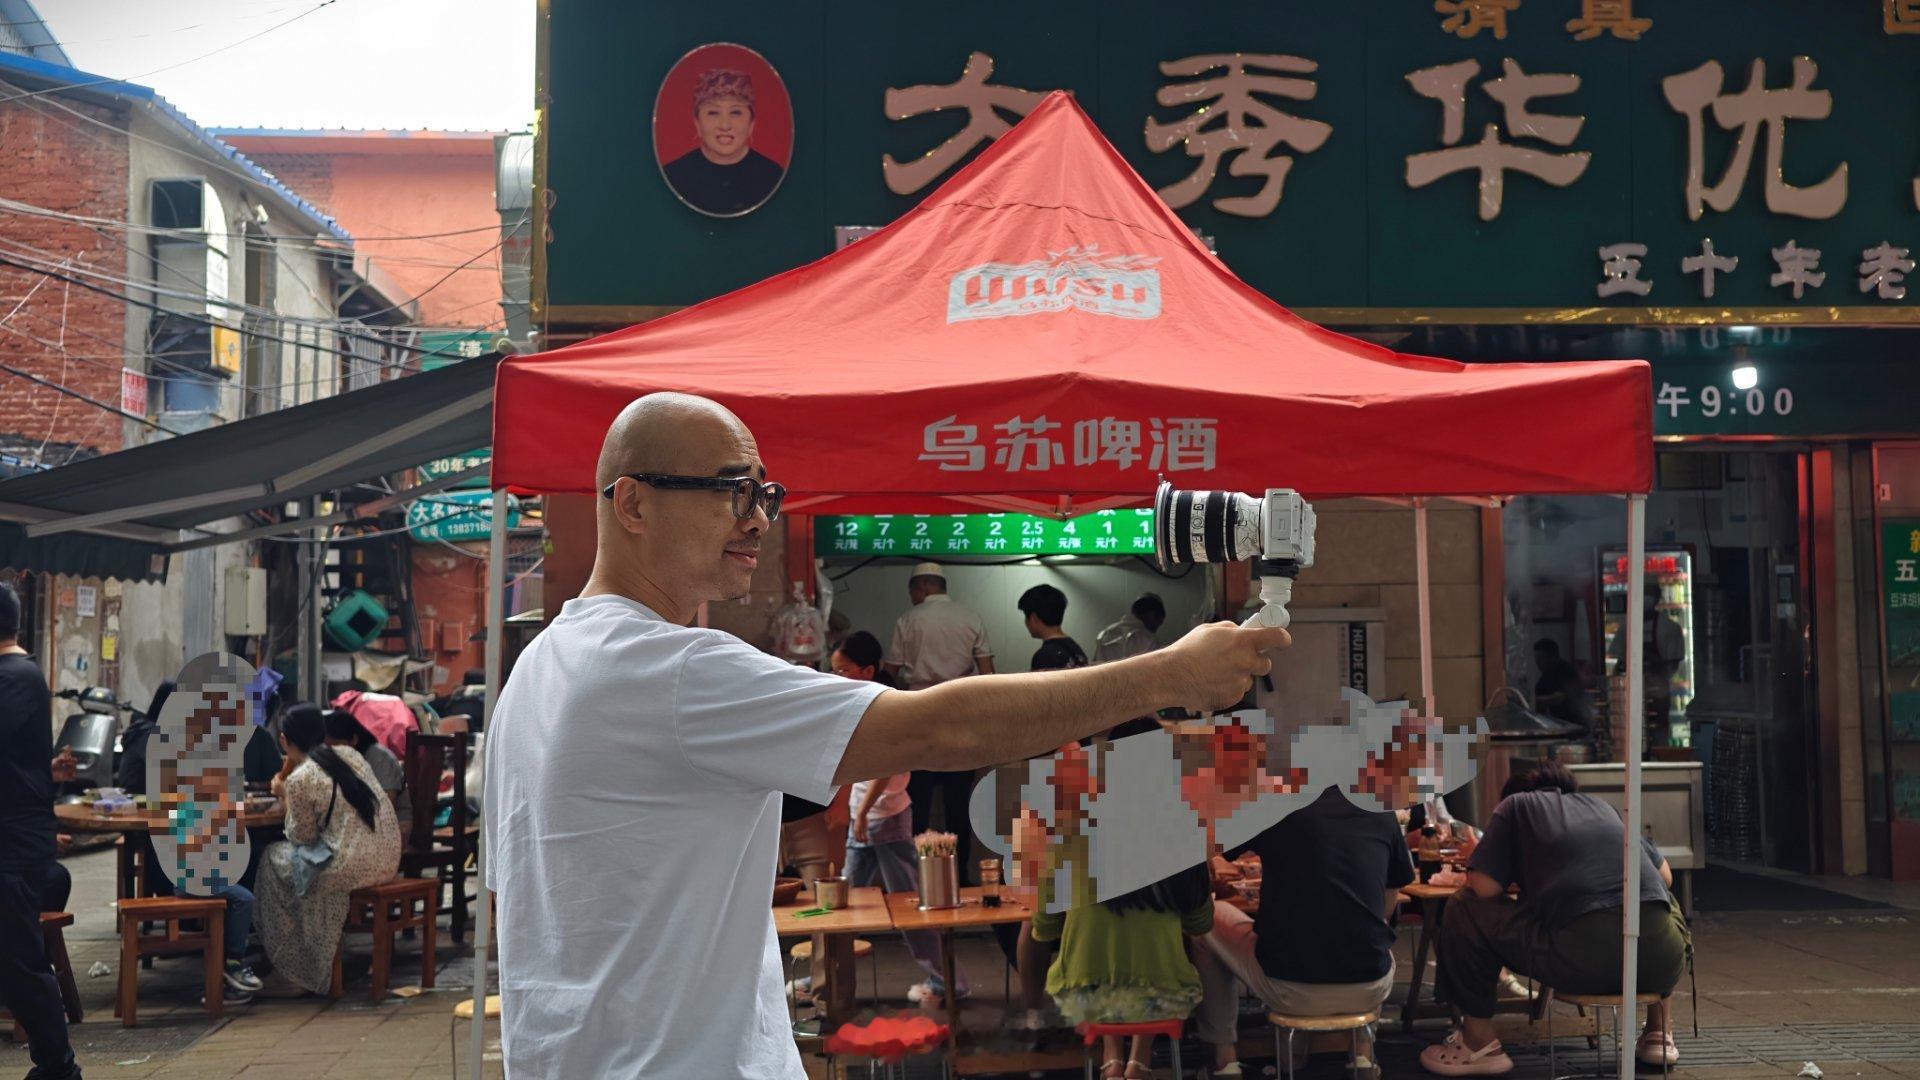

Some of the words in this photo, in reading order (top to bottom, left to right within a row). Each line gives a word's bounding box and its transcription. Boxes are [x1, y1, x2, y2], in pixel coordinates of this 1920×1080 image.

[883, 51, 1920, 221] 大秀华优
[1597, 237, 1916, 299] 五十年老
[1657, 382, 1793, 418] 午9:00
[918, 415, 1218, 472] 乌苏啤酒
[835, 522, 859, 536] 12
[878, 522, 890, 536] 7
[915, 522, 928, 536] 2
[953, 522, 965, 536] 2
[989, 521, 1002, 535] 2
[1021, 521, 1044, 535] 2.5
[1063, 521, 1076, 534] 4
[1102, 521, 1112, 534] 1
[1140, 521, 1149, 534] 1
[1894, 559, 1918, 581] 五
